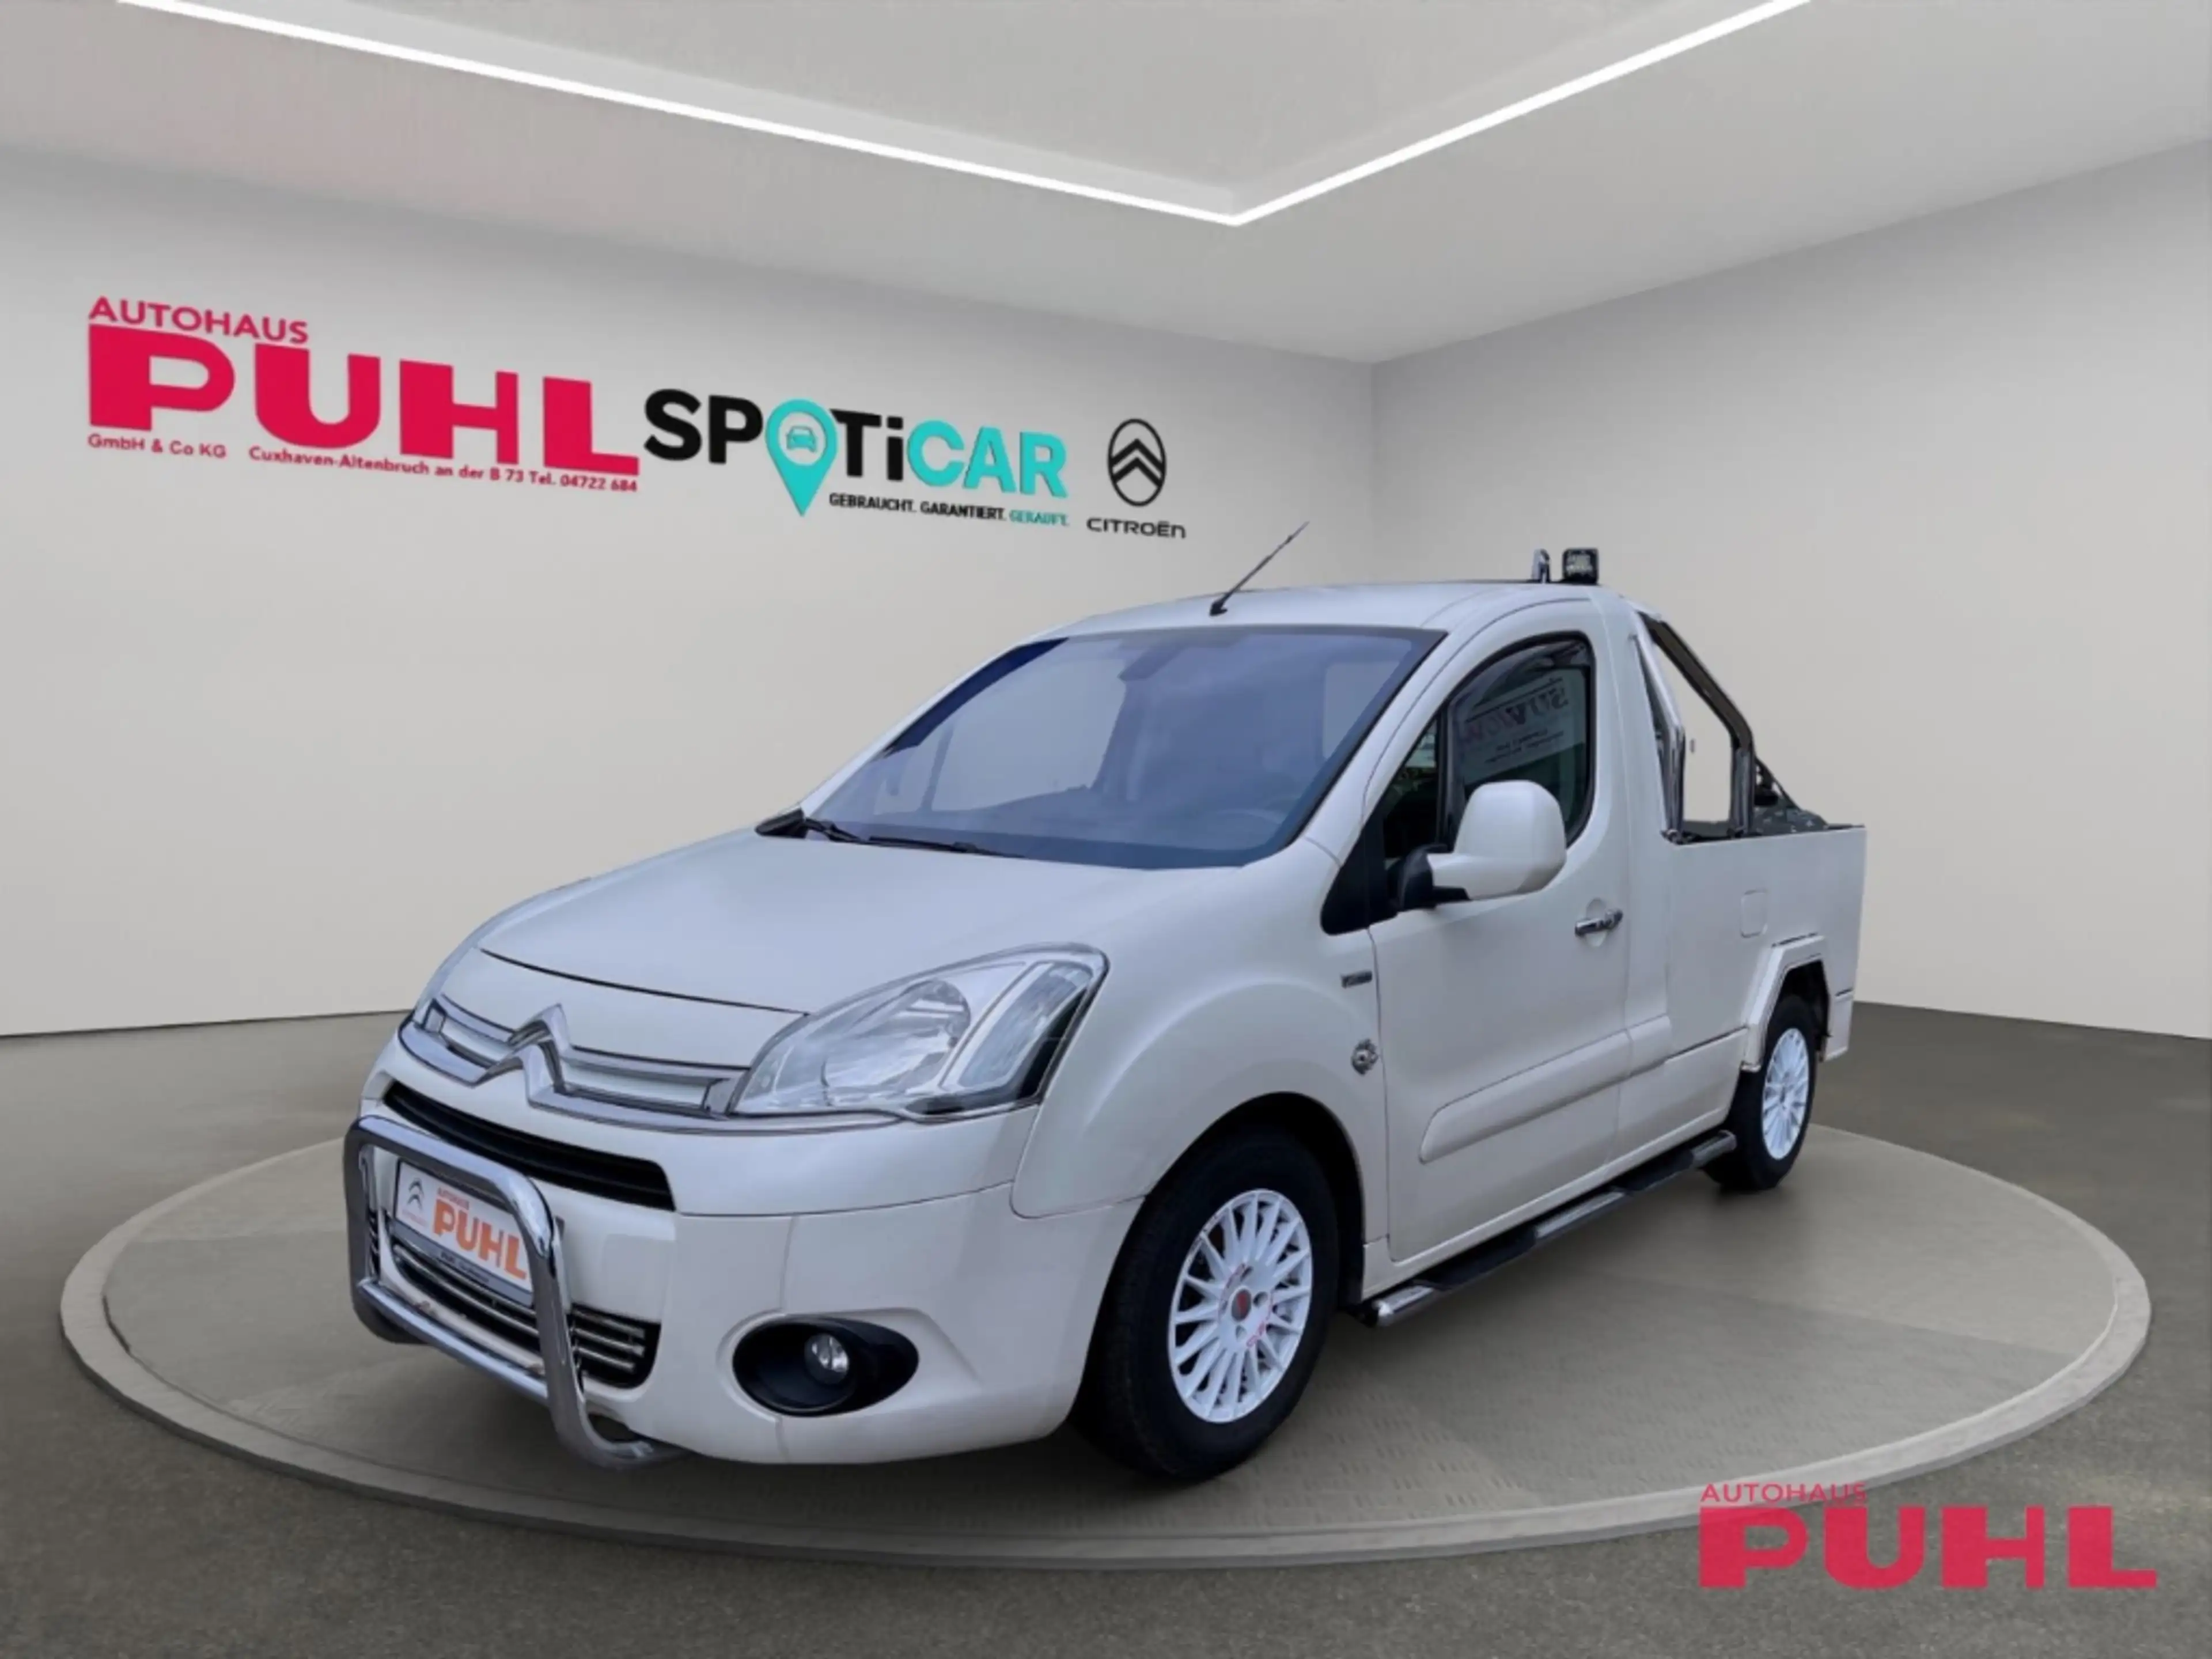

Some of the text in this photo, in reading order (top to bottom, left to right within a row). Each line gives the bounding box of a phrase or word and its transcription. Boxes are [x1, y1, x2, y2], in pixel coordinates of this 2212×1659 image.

[89, 296, 309, 343] AUTOHAUS
[89, 323, 641, 477] PUHL
[88, 433, 638, 492] GmbH & Co KG Cuxhaven-Altenbruch an der B 73 Tel. 04722 684
[829, 493, 916, 513] GEBRAUCHT.
[920, 501, 1007, 521] GARANTIERT.
[434, 1198, 527, 1280] PUHL
